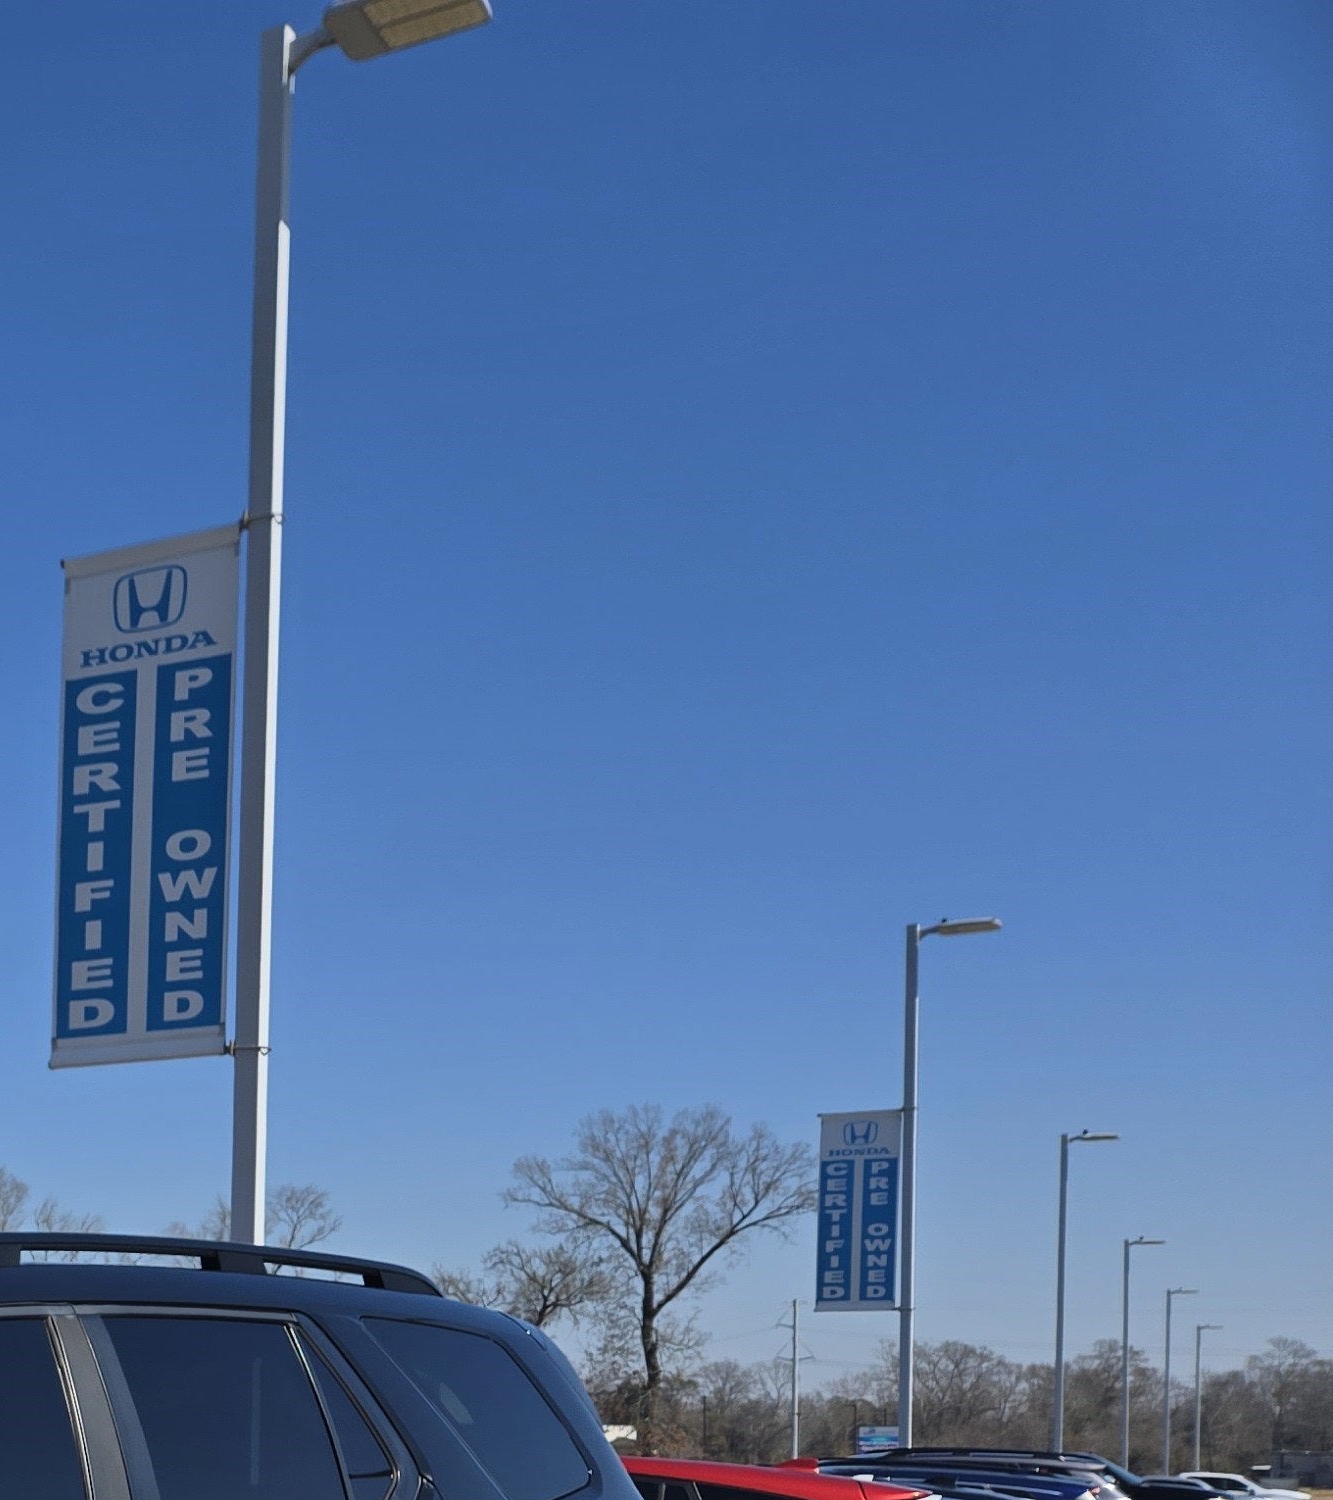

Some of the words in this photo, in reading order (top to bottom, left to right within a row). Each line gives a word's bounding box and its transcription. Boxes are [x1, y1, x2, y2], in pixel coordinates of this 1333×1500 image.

[81, 630, 217, 667] HONDA
[170, 668, 214, 782] PRE
[69, 684, 125, 1031] CERTIFIED
[157, 828, 218, 1023] OWNED
[828, 1146, 890, 1157] HONDA
[870, 1162, 889, 1205] PRE
[822, 1163, 848, 1298] CERTIFIED
[863, 1222, 892, 1299] OWNED
